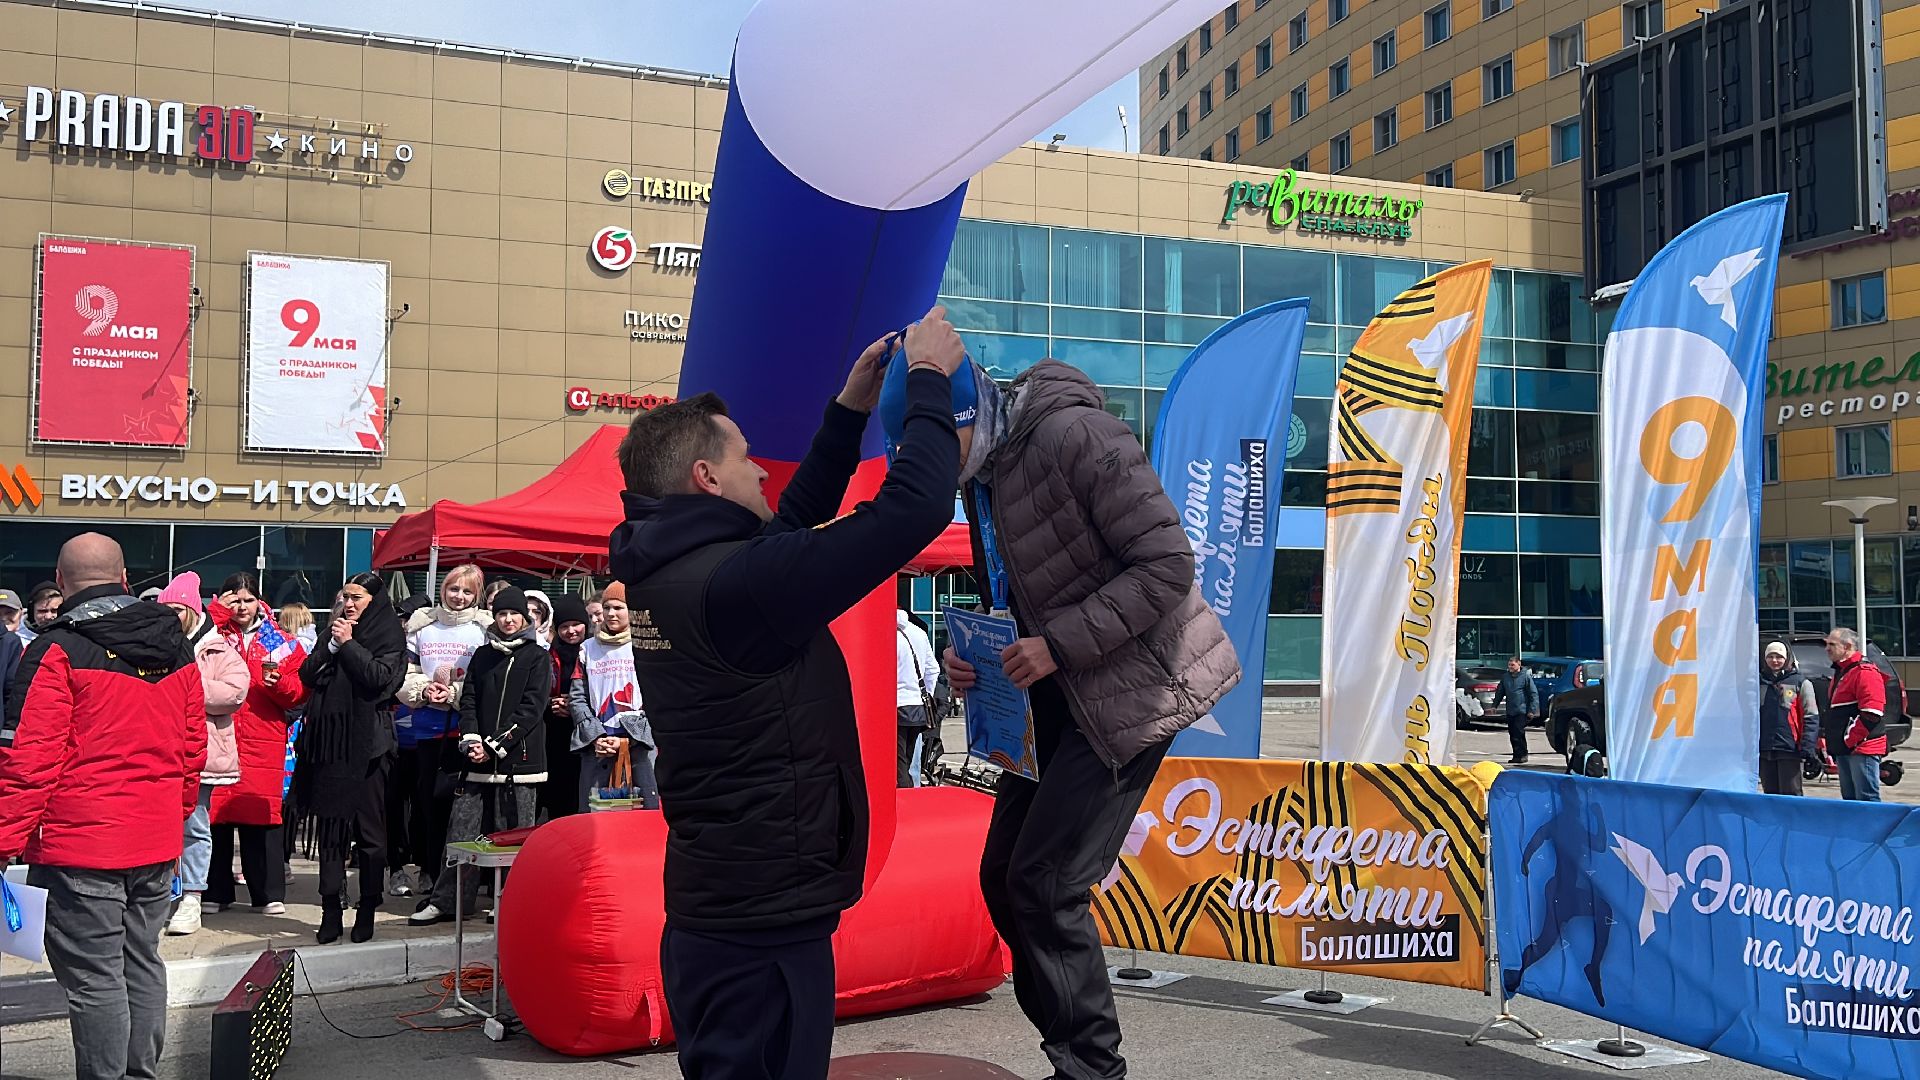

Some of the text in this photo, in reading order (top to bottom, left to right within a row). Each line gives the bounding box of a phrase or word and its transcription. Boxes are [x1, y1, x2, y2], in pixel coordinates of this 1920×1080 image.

[25, 85, 185, 157] PRADA
[299, 134, 414, 162] КИНО
[1302, 215, 1413, 239] СПА-КЛУБ
[75, 284, 158, 340] 9 мая
[281, 298, 357, 350] 9 мая
[625, 309, 684, 329] ПИКО
[72, 346, 159, 360] С ПРАЗДНИКОМ
[72, 357, 123, 369] ПОБЕДЫ!
[280, 358, 357, 370] С ПРАЗДНИКОМ
[280, 369, 326, 379] ПОБЕДЫ!
[597, 393, 678, 411] АЛЬФА
[1639, 395, 1738, 524] 9
[287, 480, 407, 507] ТОЧКА
[1242, 441, 1266, 547] Балашиха
[1464, 556, 1487, 573] UZ
[1393, 472, 1443, 766] ень Победы
[420, 648, 474, 657] ОДМОСКОВЬЯ
[596, 659, 635, 669] ВОЛОНТЕР
[590, 665, 636, 676] ПОДМОСКОВ
[1162, 776, 1452, 883] Эстафета
[1227, 875, 1446, 928] памяти
[1684, 843, 1914, 947] Эстафета
[1300, 926, 1454, 963] Балашиха
[1742, 935, 1914, 1000] памяти
